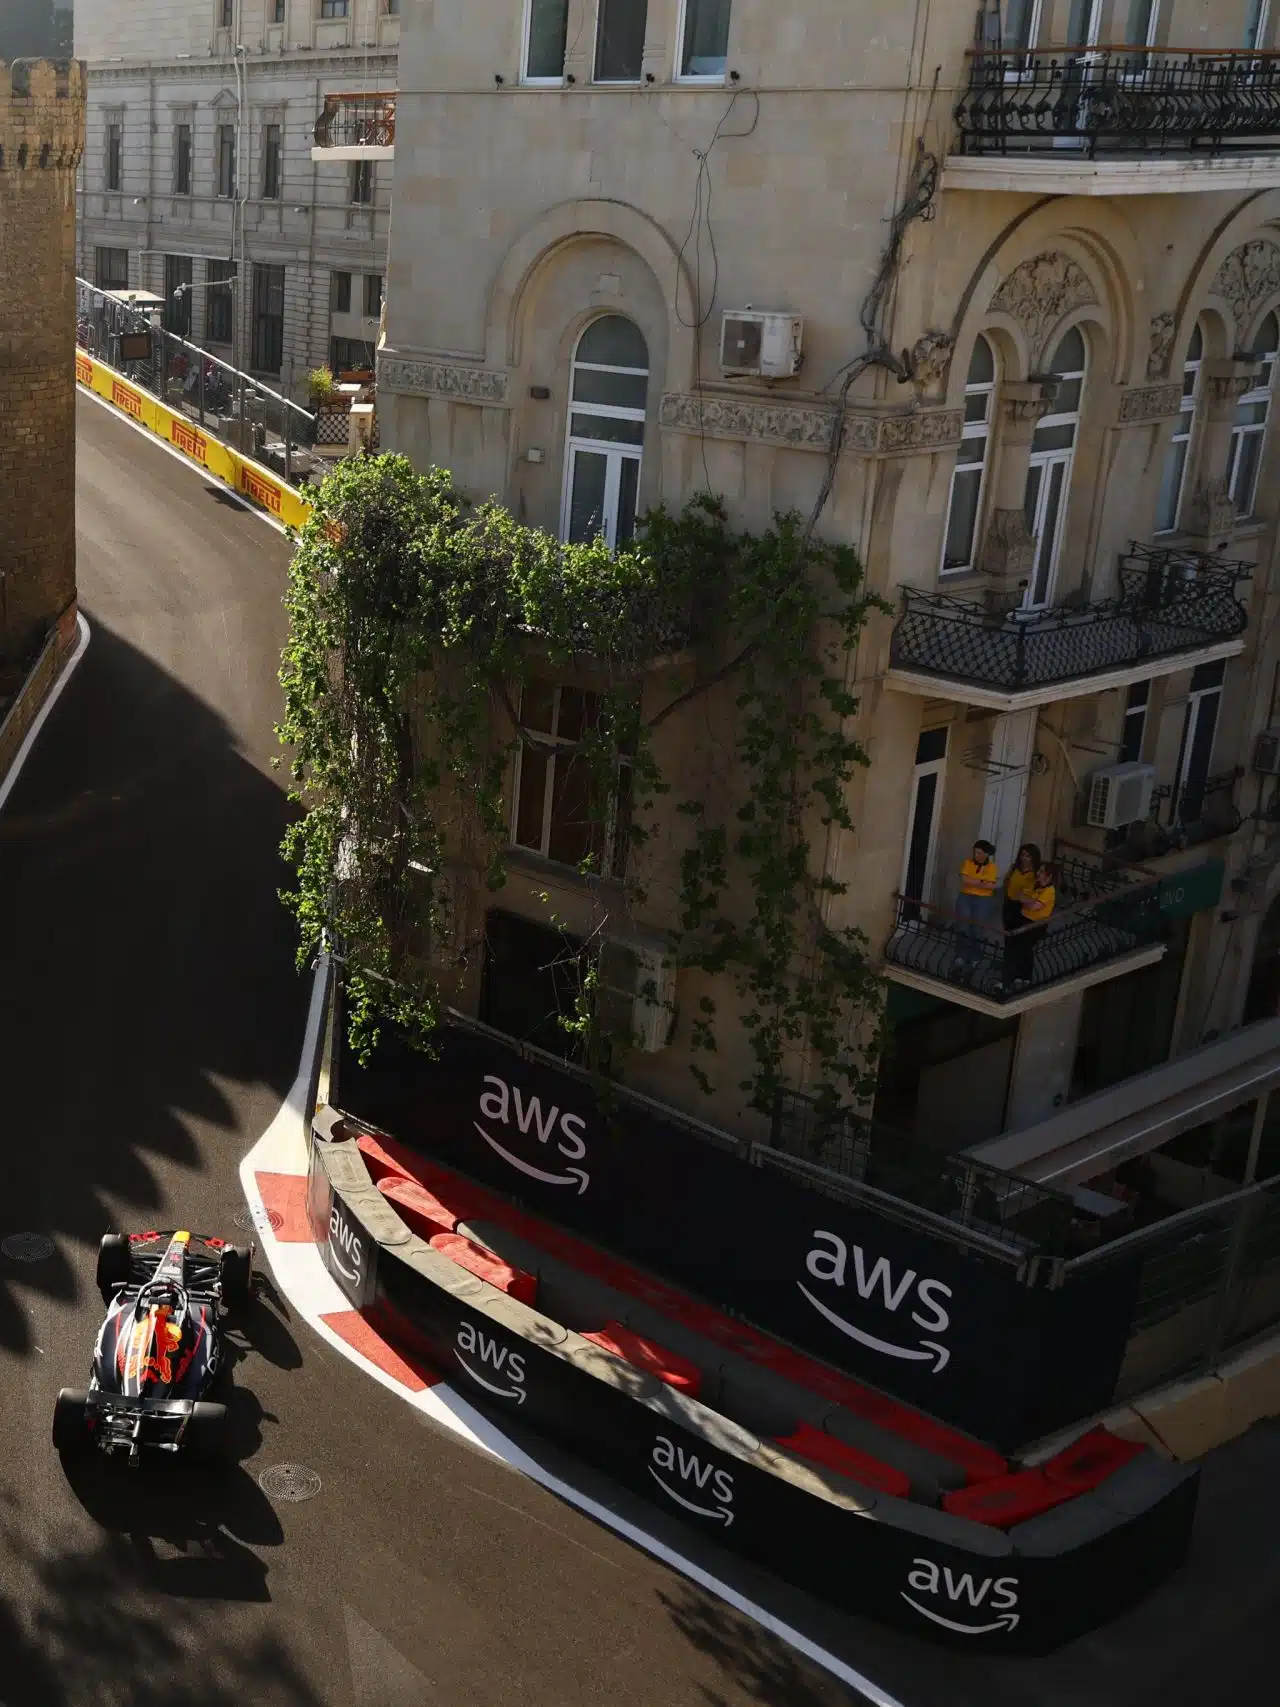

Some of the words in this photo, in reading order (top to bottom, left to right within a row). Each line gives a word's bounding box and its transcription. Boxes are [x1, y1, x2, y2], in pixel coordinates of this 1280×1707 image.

[112, 379, 142, 418] PIRELLI
[172, 419, 207, 461] PIRELLI
[242, 465, 282, 513] PIRELLI
[480, 1075, 586, 1160] aws
[330, 1206, 362, 1266] aws
[806, 1230, 953, 1333] aws
[458, 1321, 526, 1383] aws
[652, 1435, 734, 1503] aws
[908, 1558, 1019, 1609] aws
